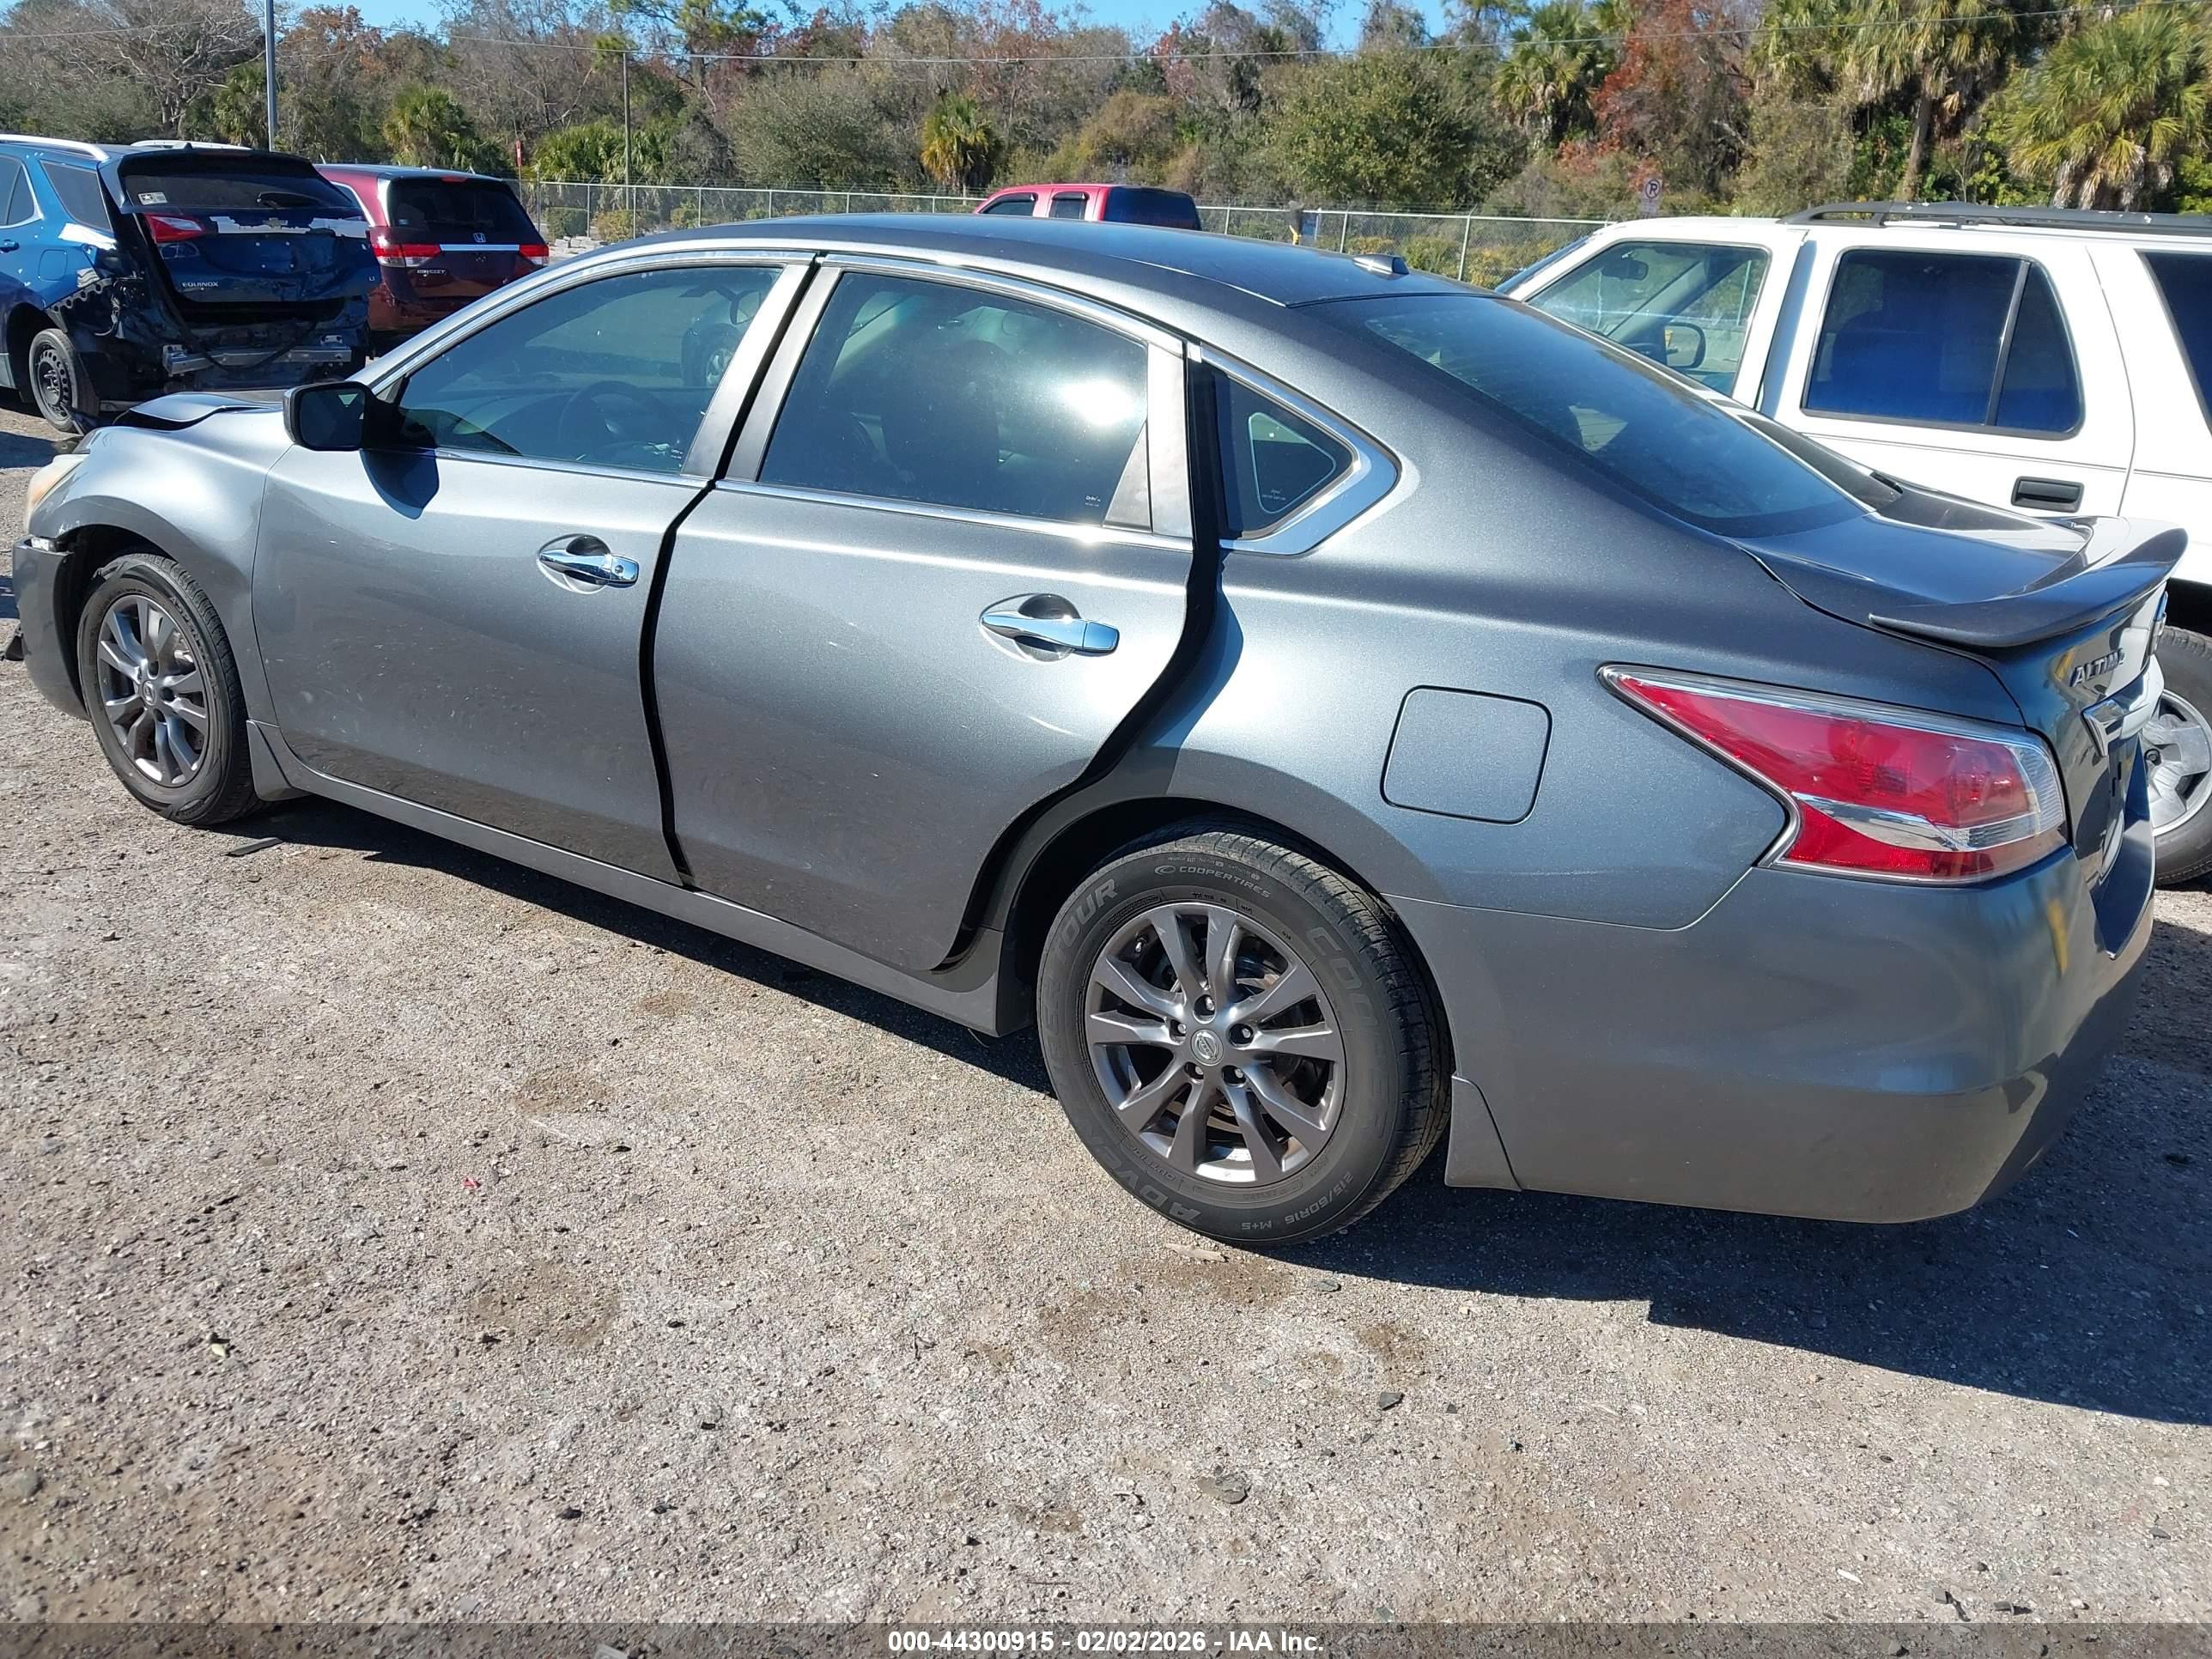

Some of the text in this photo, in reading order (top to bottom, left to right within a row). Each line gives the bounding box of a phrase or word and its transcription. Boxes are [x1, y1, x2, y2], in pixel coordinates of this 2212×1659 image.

[2069, 647, 2125, 688] ALTIMA
[1179, 866, 1271, 898] COOPERTIRES
[1056, 878, 1117, 963] TOUR
[1305, 927, 1393, 1140] COOER
[1242, 1170, 1354, 1231] 215/60R16 M+S
